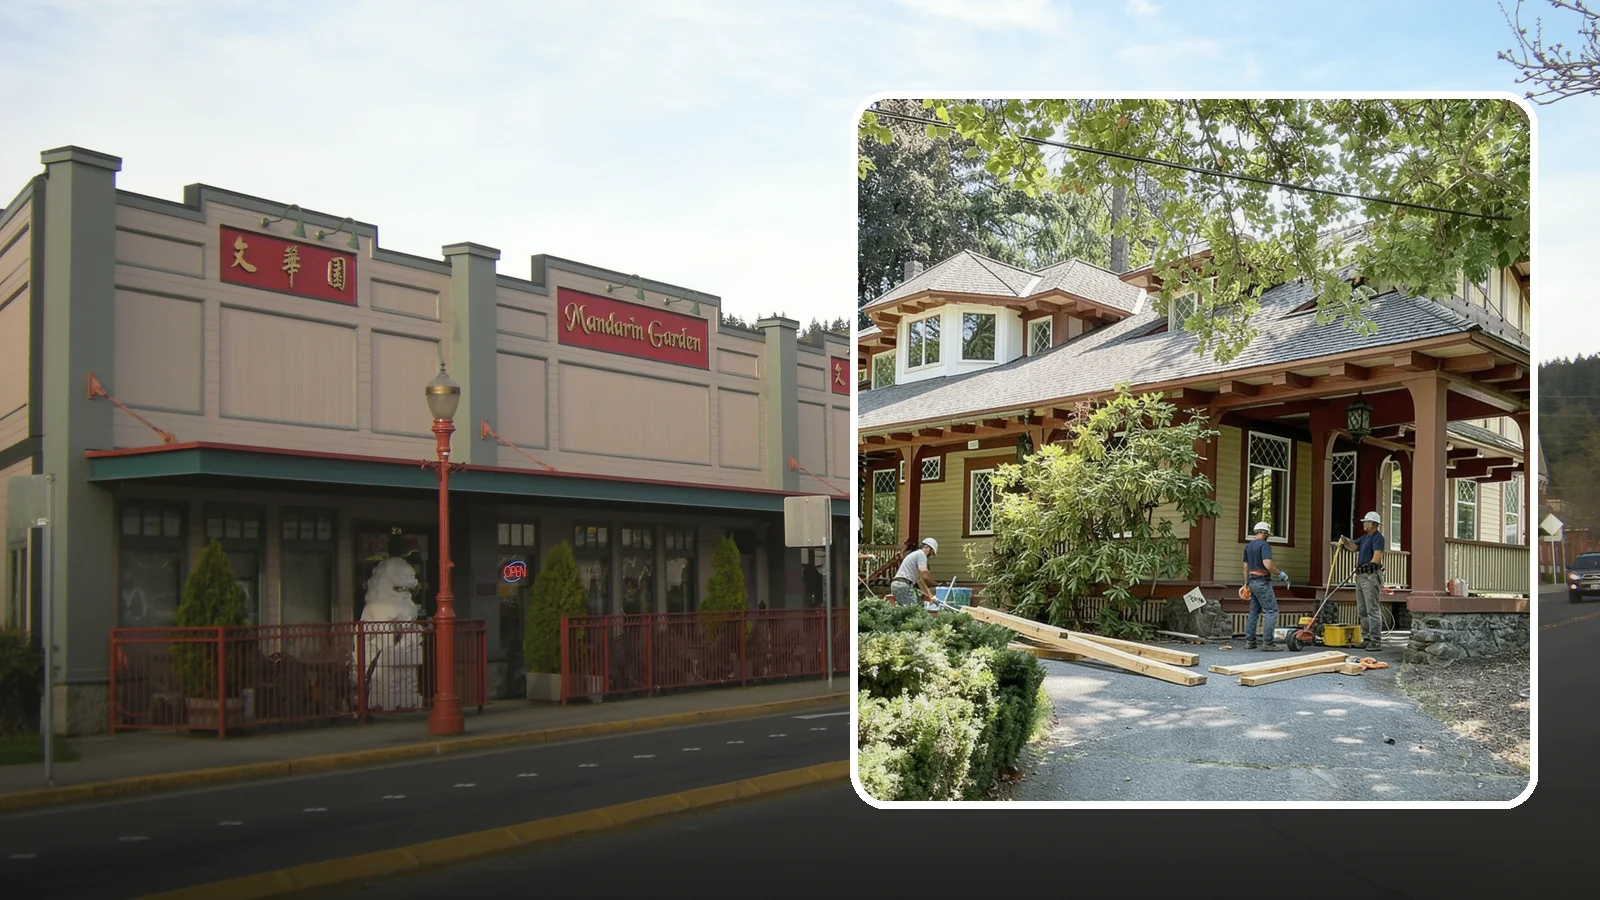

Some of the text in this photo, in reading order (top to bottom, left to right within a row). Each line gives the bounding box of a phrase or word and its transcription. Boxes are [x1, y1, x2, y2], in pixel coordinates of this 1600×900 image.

[231, 236, 346, 290] 文華園
[564, 302, 702, 352] Mandarin Garden
[503, 565, 527, 578] OPEN
